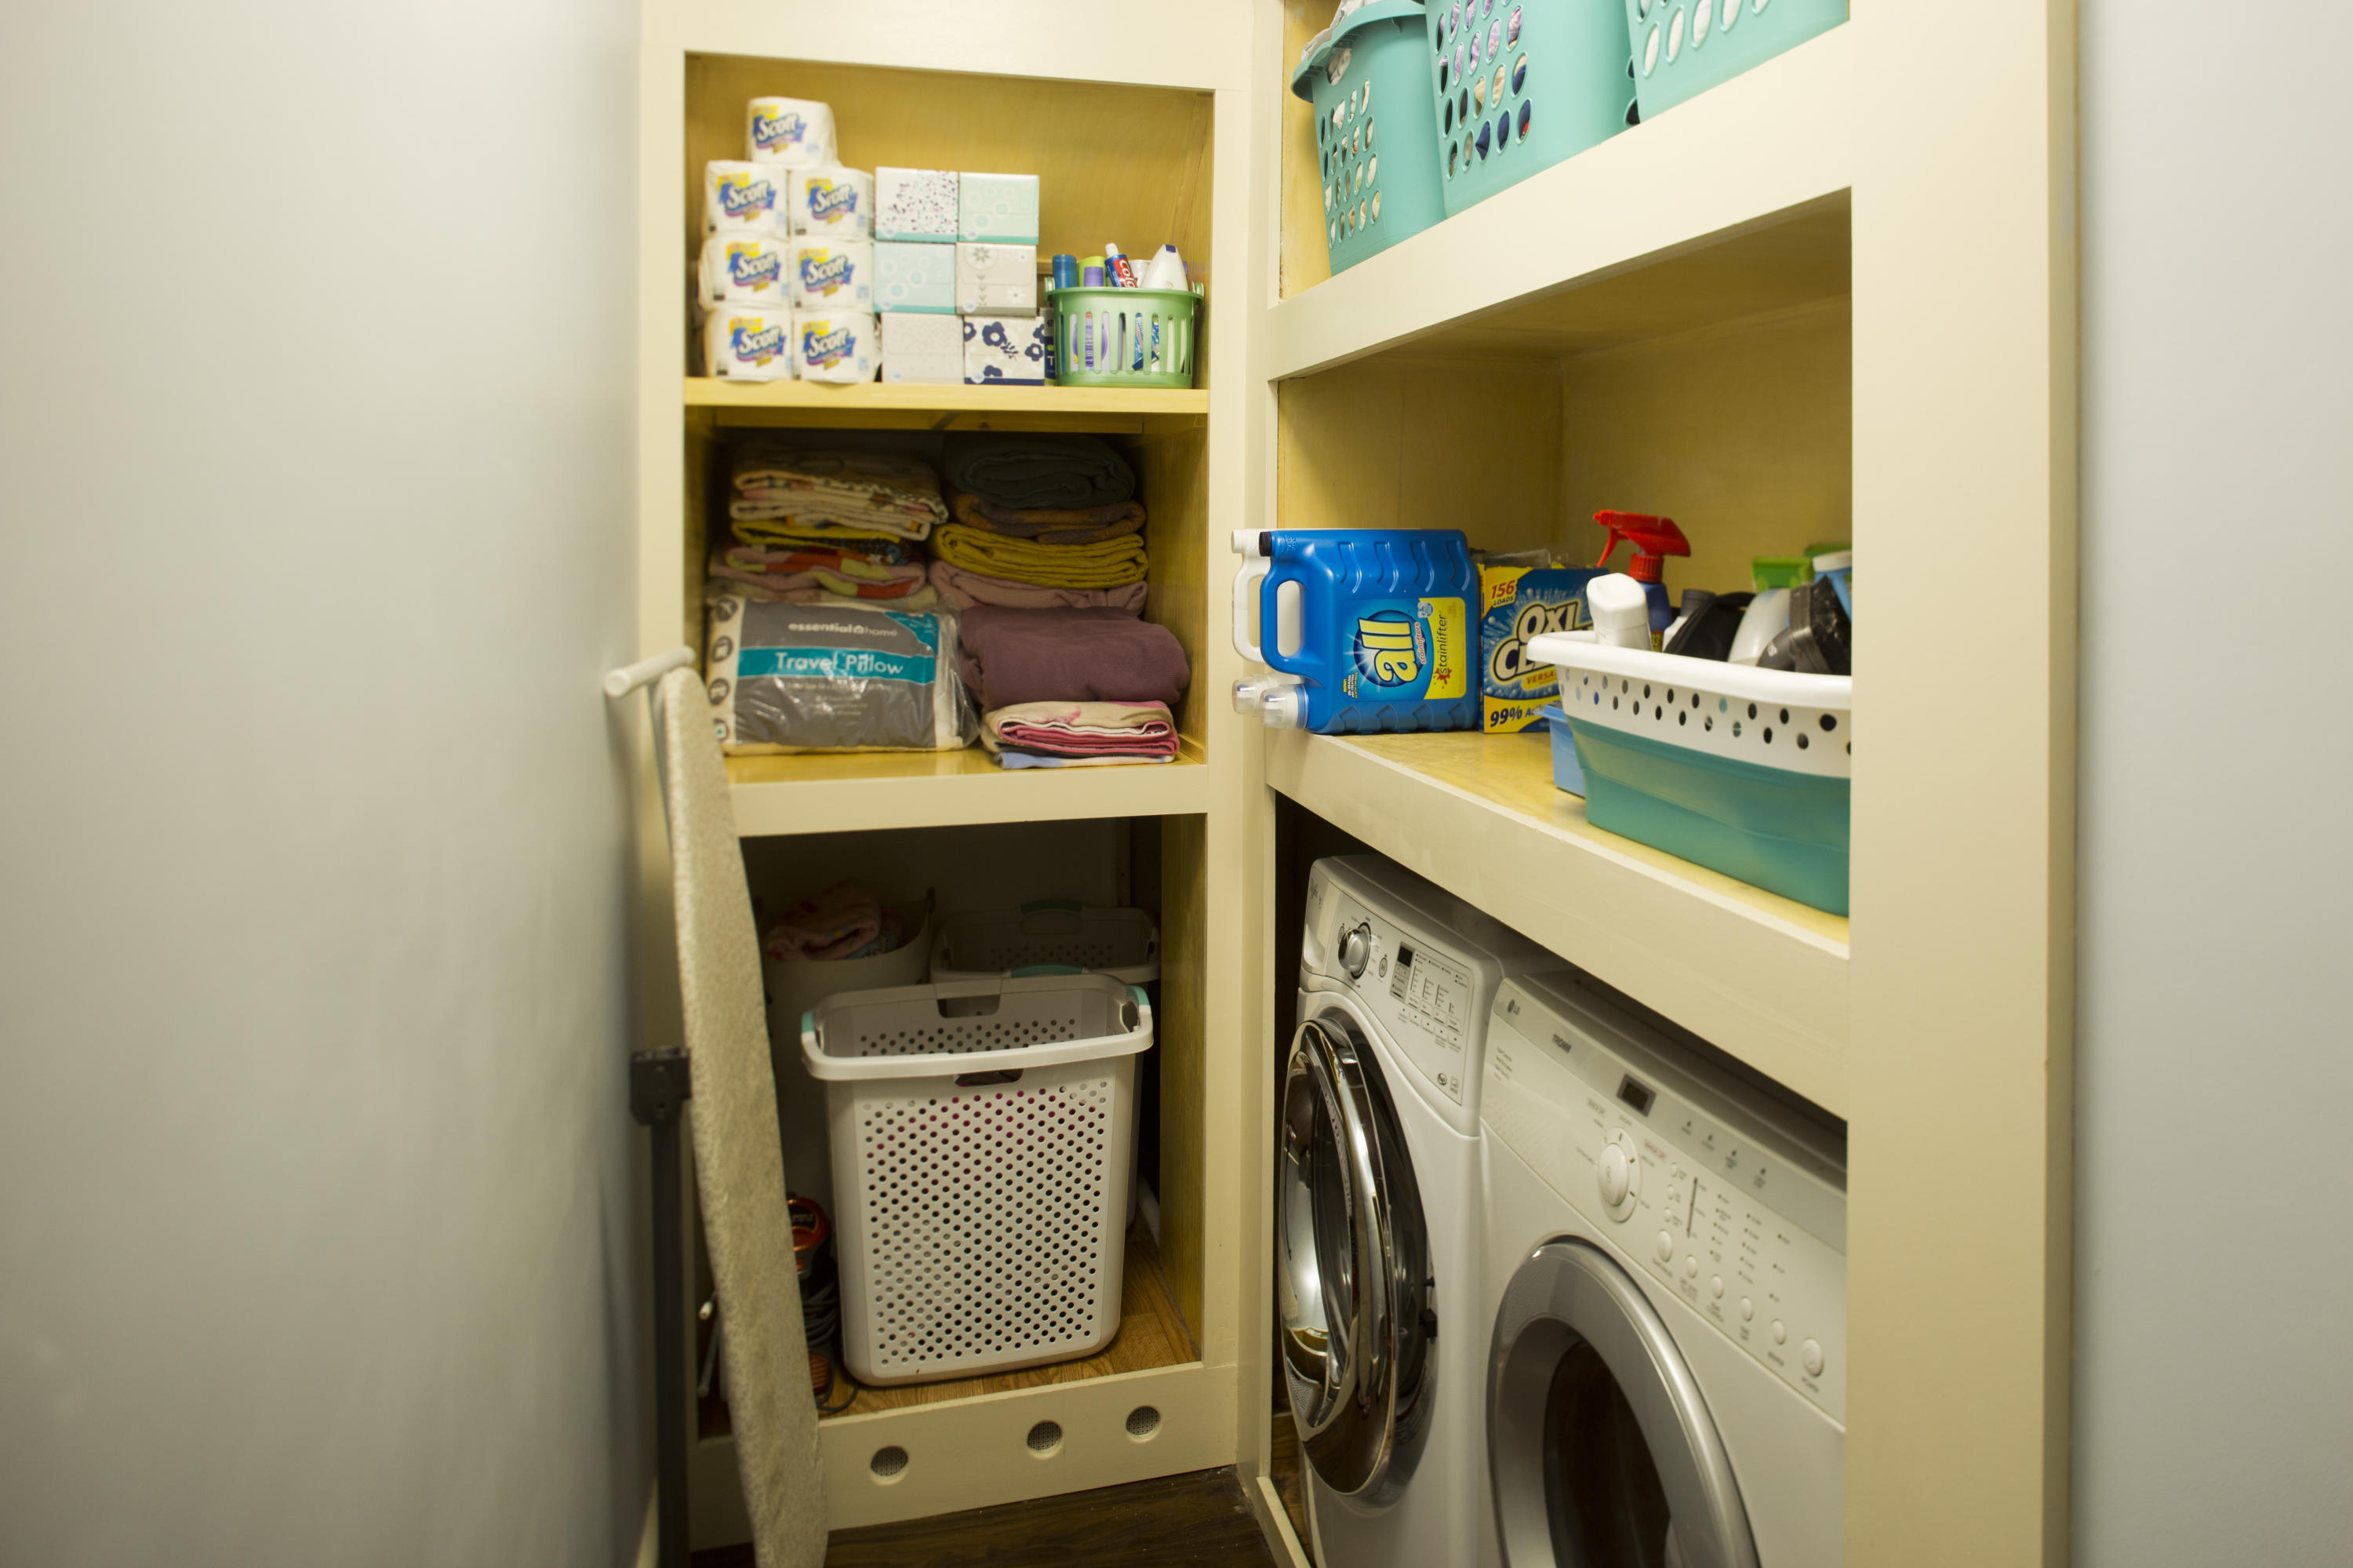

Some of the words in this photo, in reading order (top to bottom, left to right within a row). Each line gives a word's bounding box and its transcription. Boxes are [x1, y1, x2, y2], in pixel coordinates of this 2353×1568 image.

[1491, 580, 1515, 599] 156
[1493, 595, 1514, 606] LOADS
[864, 624, 898, 637] home
[1517, 601, 1579, 645] OXI
[1358, 617, 1417, 682] all
[1414, 621, 1427, 664] stainlifters
[1436, 614, 1448, 674] stainlifter
[775, 653, 839, 671] Travel
[846, 654, 904, 675] Pillow
[1526, 672, 1557, 685] VERSA
[1490, 706, 1522, 727] 99%
